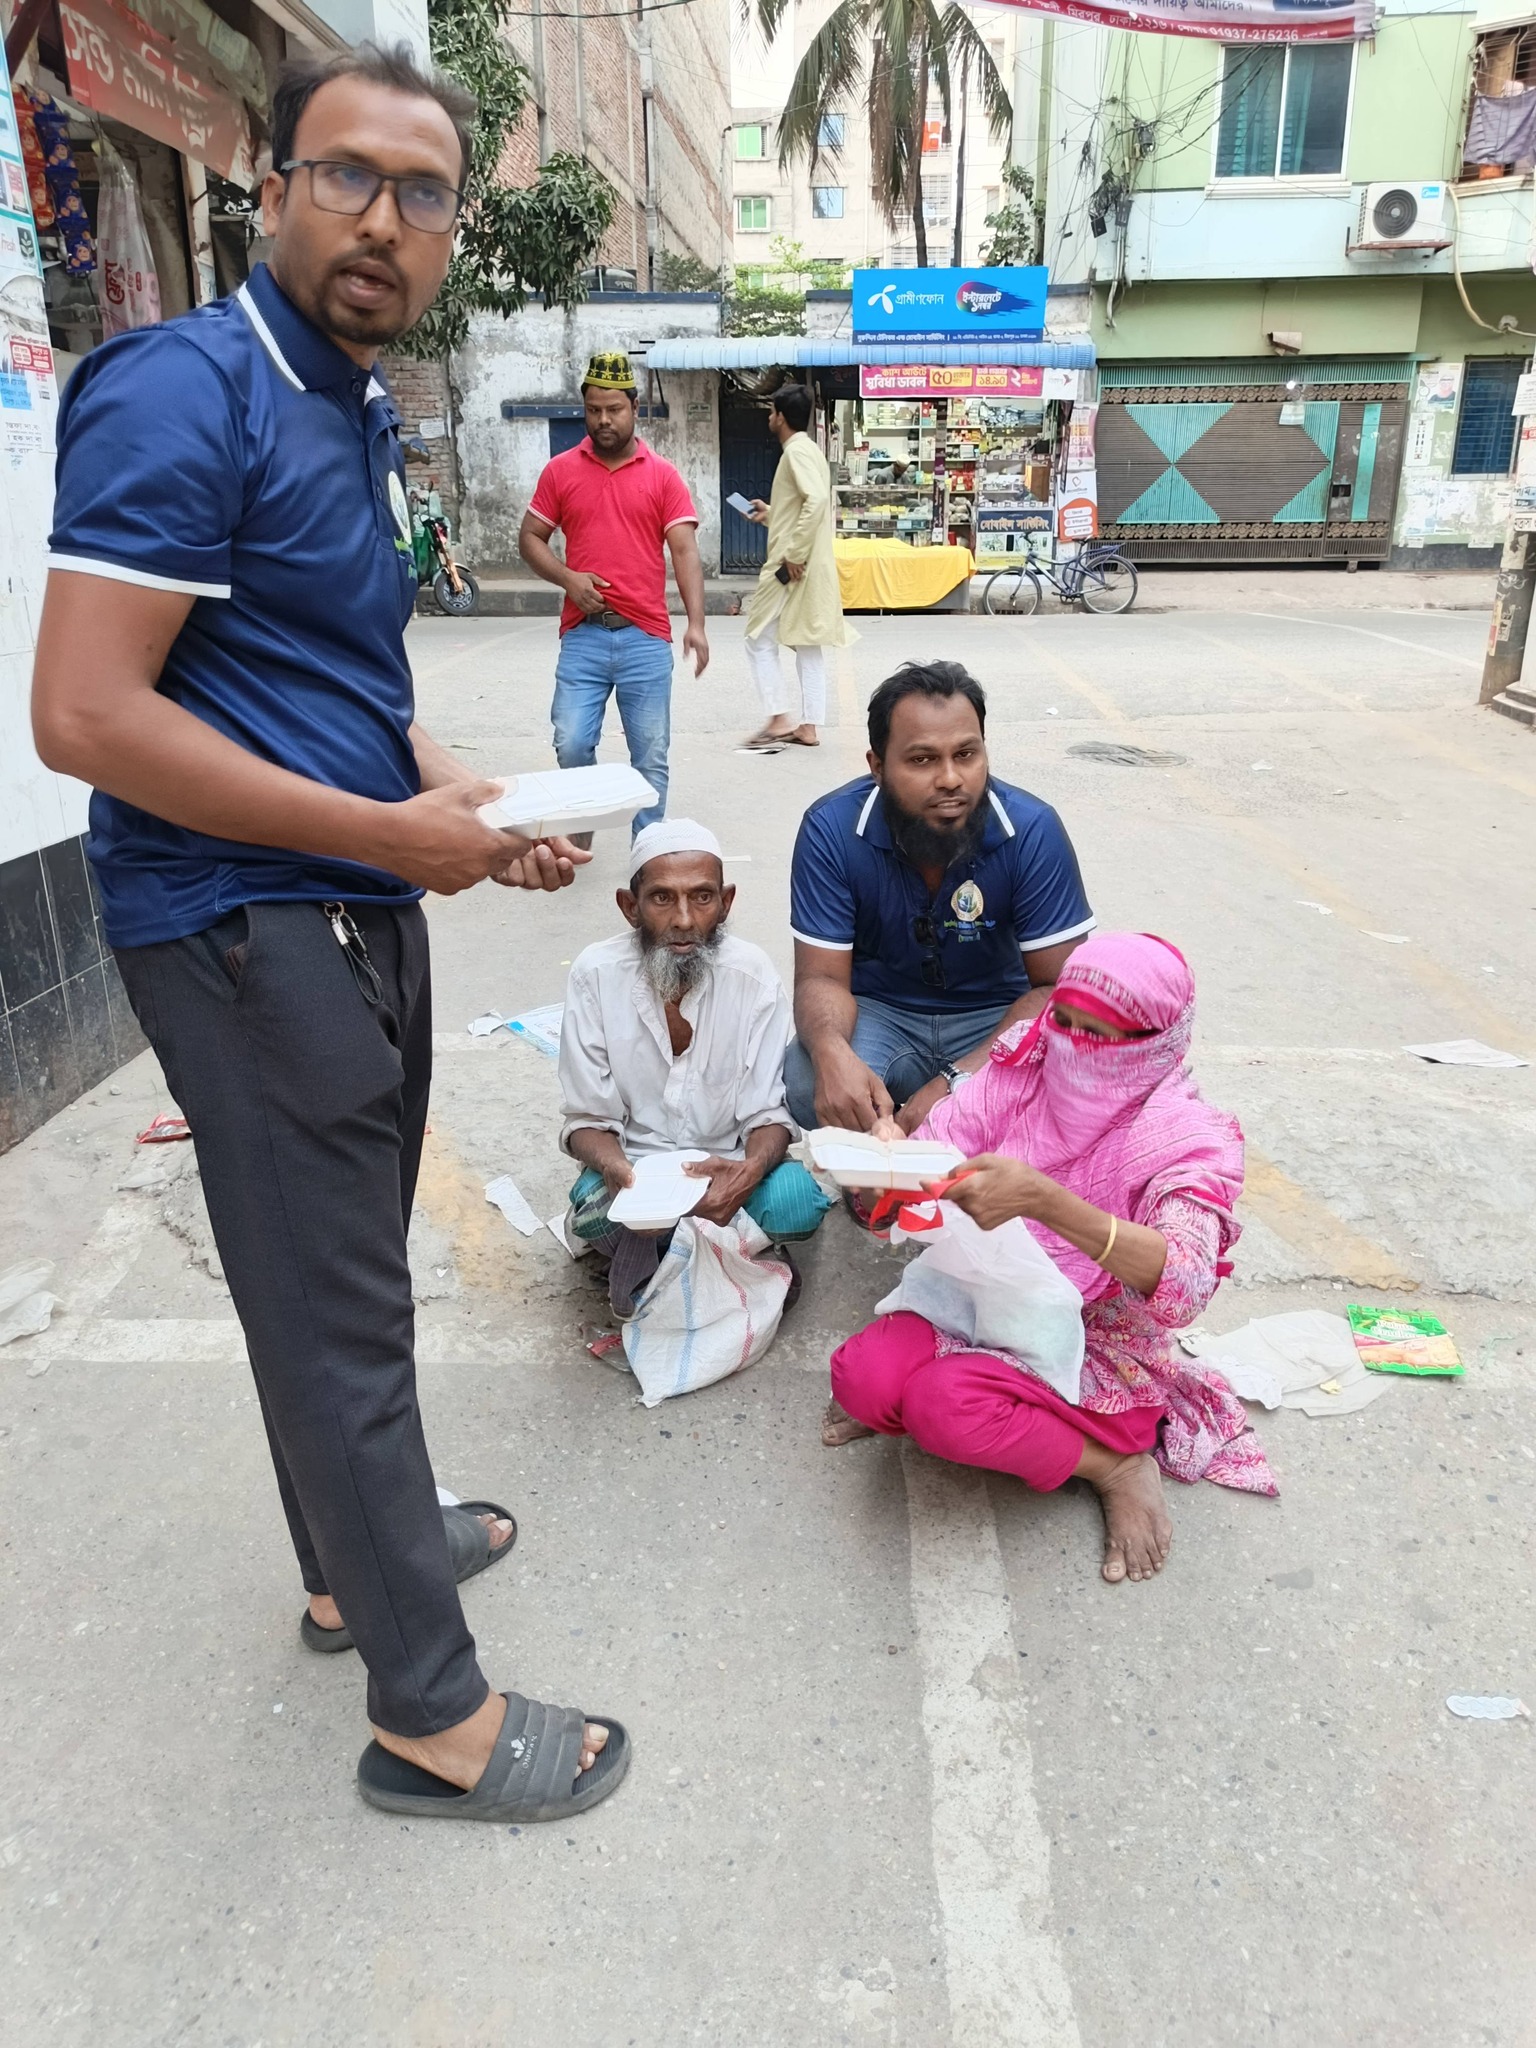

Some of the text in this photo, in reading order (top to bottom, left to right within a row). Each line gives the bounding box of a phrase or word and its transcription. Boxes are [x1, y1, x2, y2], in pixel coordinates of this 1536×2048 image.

[1209, 26, 1299, 41] 01937-275236
[895, 290, 945, 305] গ্রামীণফোন
[865, 374, 896, 390] সুবিধা
[897, 376, 928, 388] ডাবল
[932, 371, 953, 385] ৫০
[979, 376, 1006, 386] ১৪.৯০
